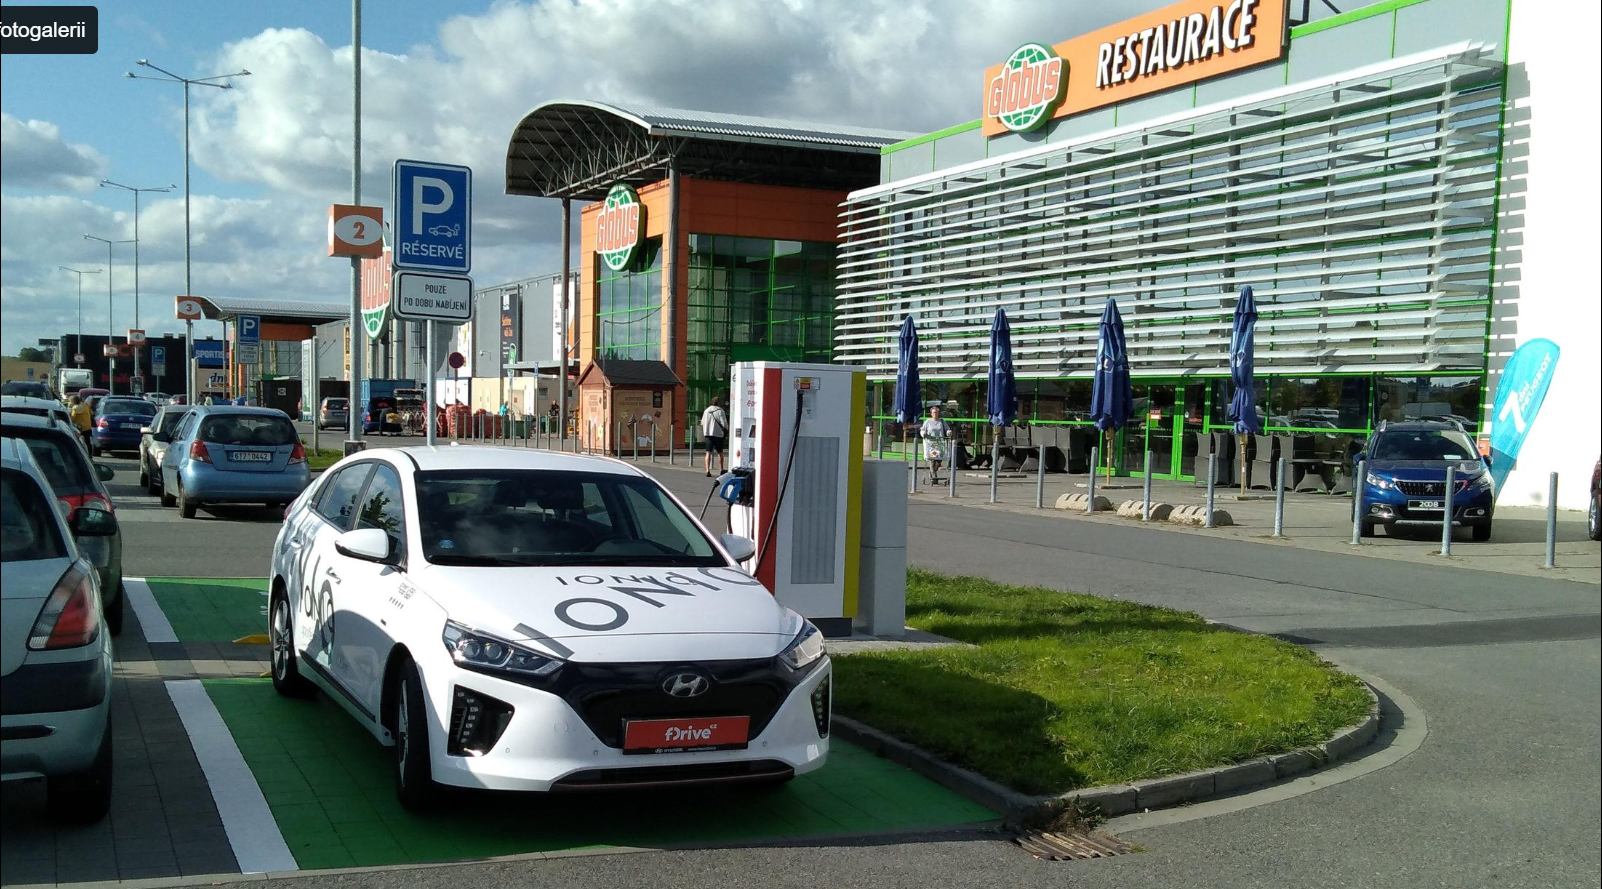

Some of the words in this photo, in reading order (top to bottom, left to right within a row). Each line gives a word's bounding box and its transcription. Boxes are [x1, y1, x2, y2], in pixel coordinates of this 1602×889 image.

[1095, 0, 1256, 88] RESTAURACE
[412, 175, 454, 235] P
[352, 221, 366, 240] 2
[402, 239, 464, 260] RÉSERVÉ
[424, 283, 447, 295] POUZE
[186, 303, 193, 312] 3
[403, 296, 413, 307] PO
[415, 297, 434, 308] DOBU
[435, 298, 467, 311] NABÍJENÍ
[243, 318, 256, 335] P
[154, 348, 163, 358] P
[1499, 388, 1527, 435] 7
[251, 453, 269, 461] 0442
[664, 725, 712, 742] fDrive
